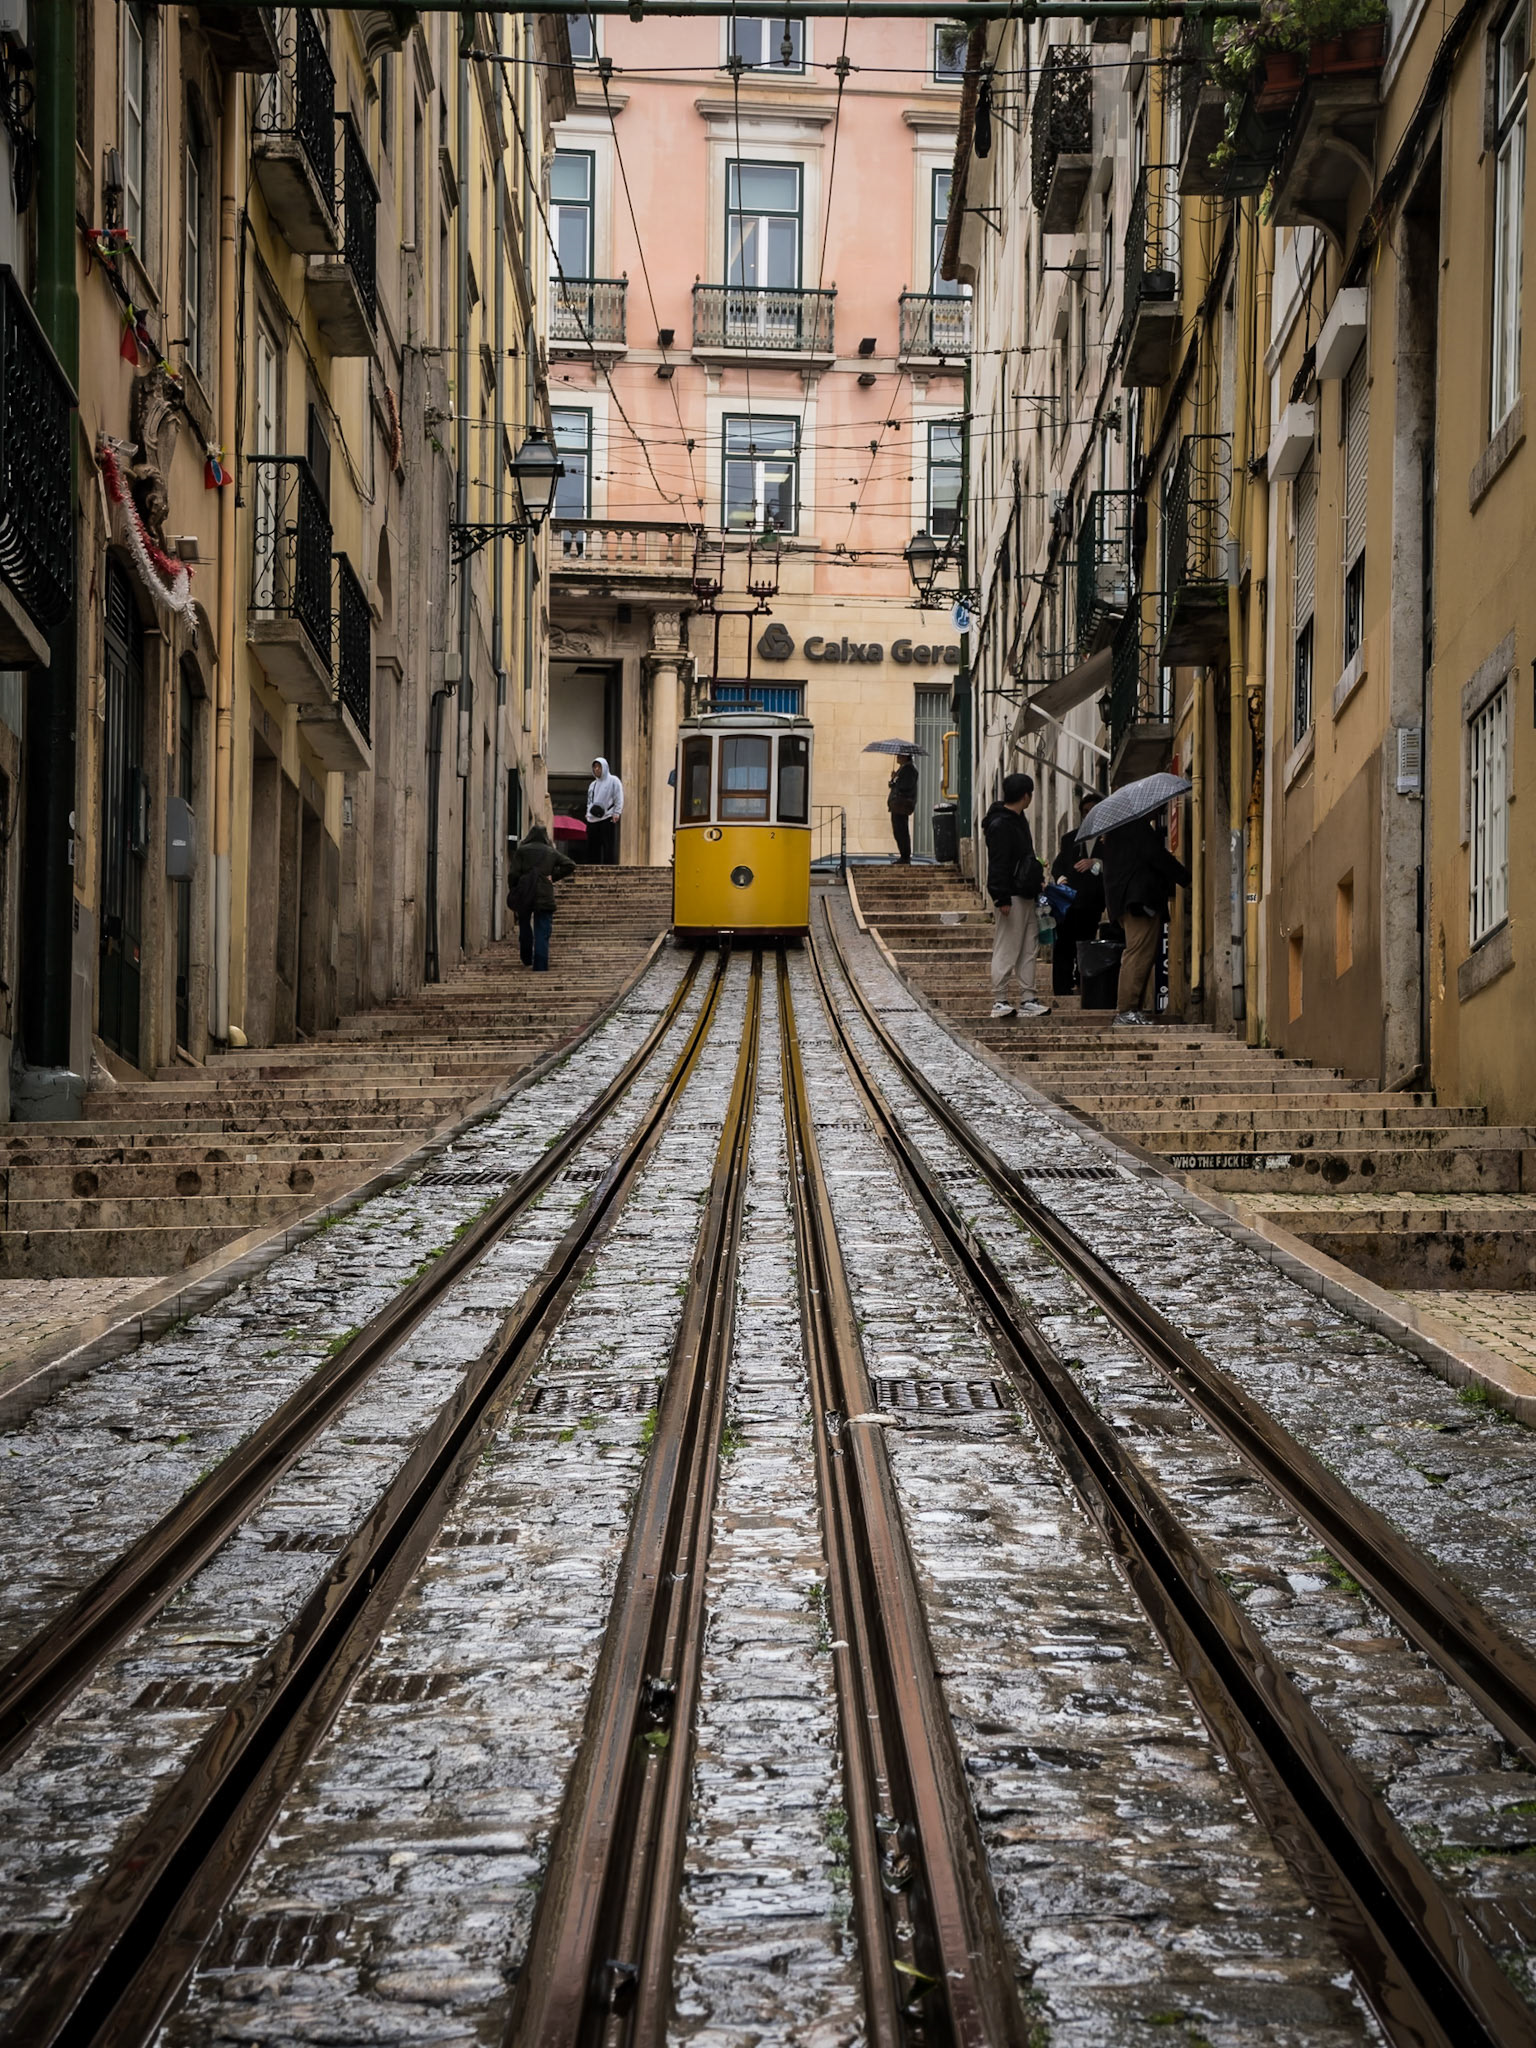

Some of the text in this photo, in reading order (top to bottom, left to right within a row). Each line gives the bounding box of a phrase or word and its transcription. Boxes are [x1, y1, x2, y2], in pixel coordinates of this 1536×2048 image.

[803, 636, 961, 665] Caixa Gera
[770, 831, 776, 840] 2
[1172, 1156, 1196, 1168] WHO
[1197, 1156, 1214, 1168] THE
